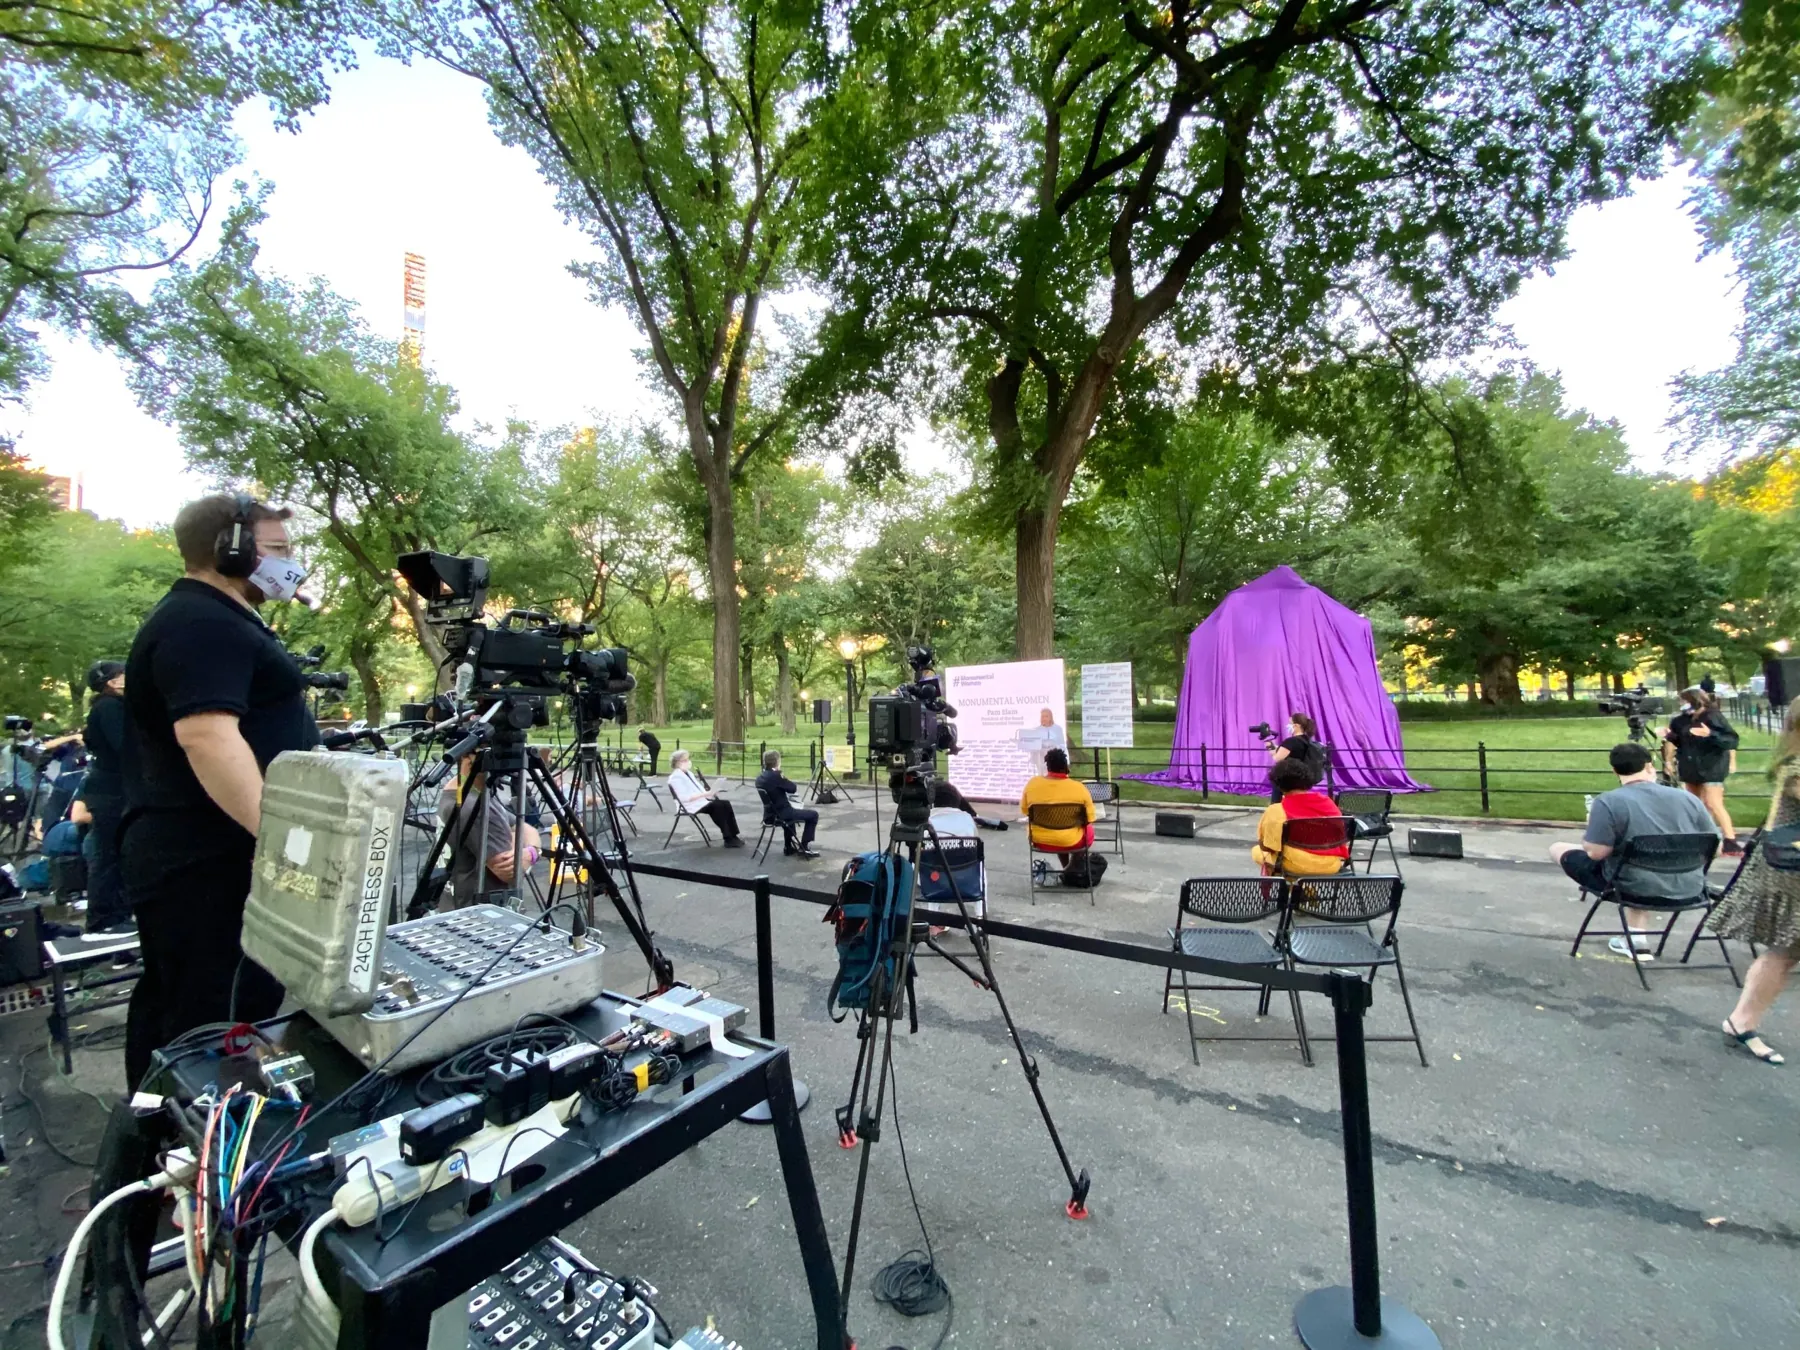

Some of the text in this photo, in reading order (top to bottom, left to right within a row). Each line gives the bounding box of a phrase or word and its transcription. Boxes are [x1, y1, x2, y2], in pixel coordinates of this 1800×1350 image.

[958, 695, 1050, 707] MONUMENTAL WOMEN
[353, 826, 390, 973] 24CH PRESS BOX
